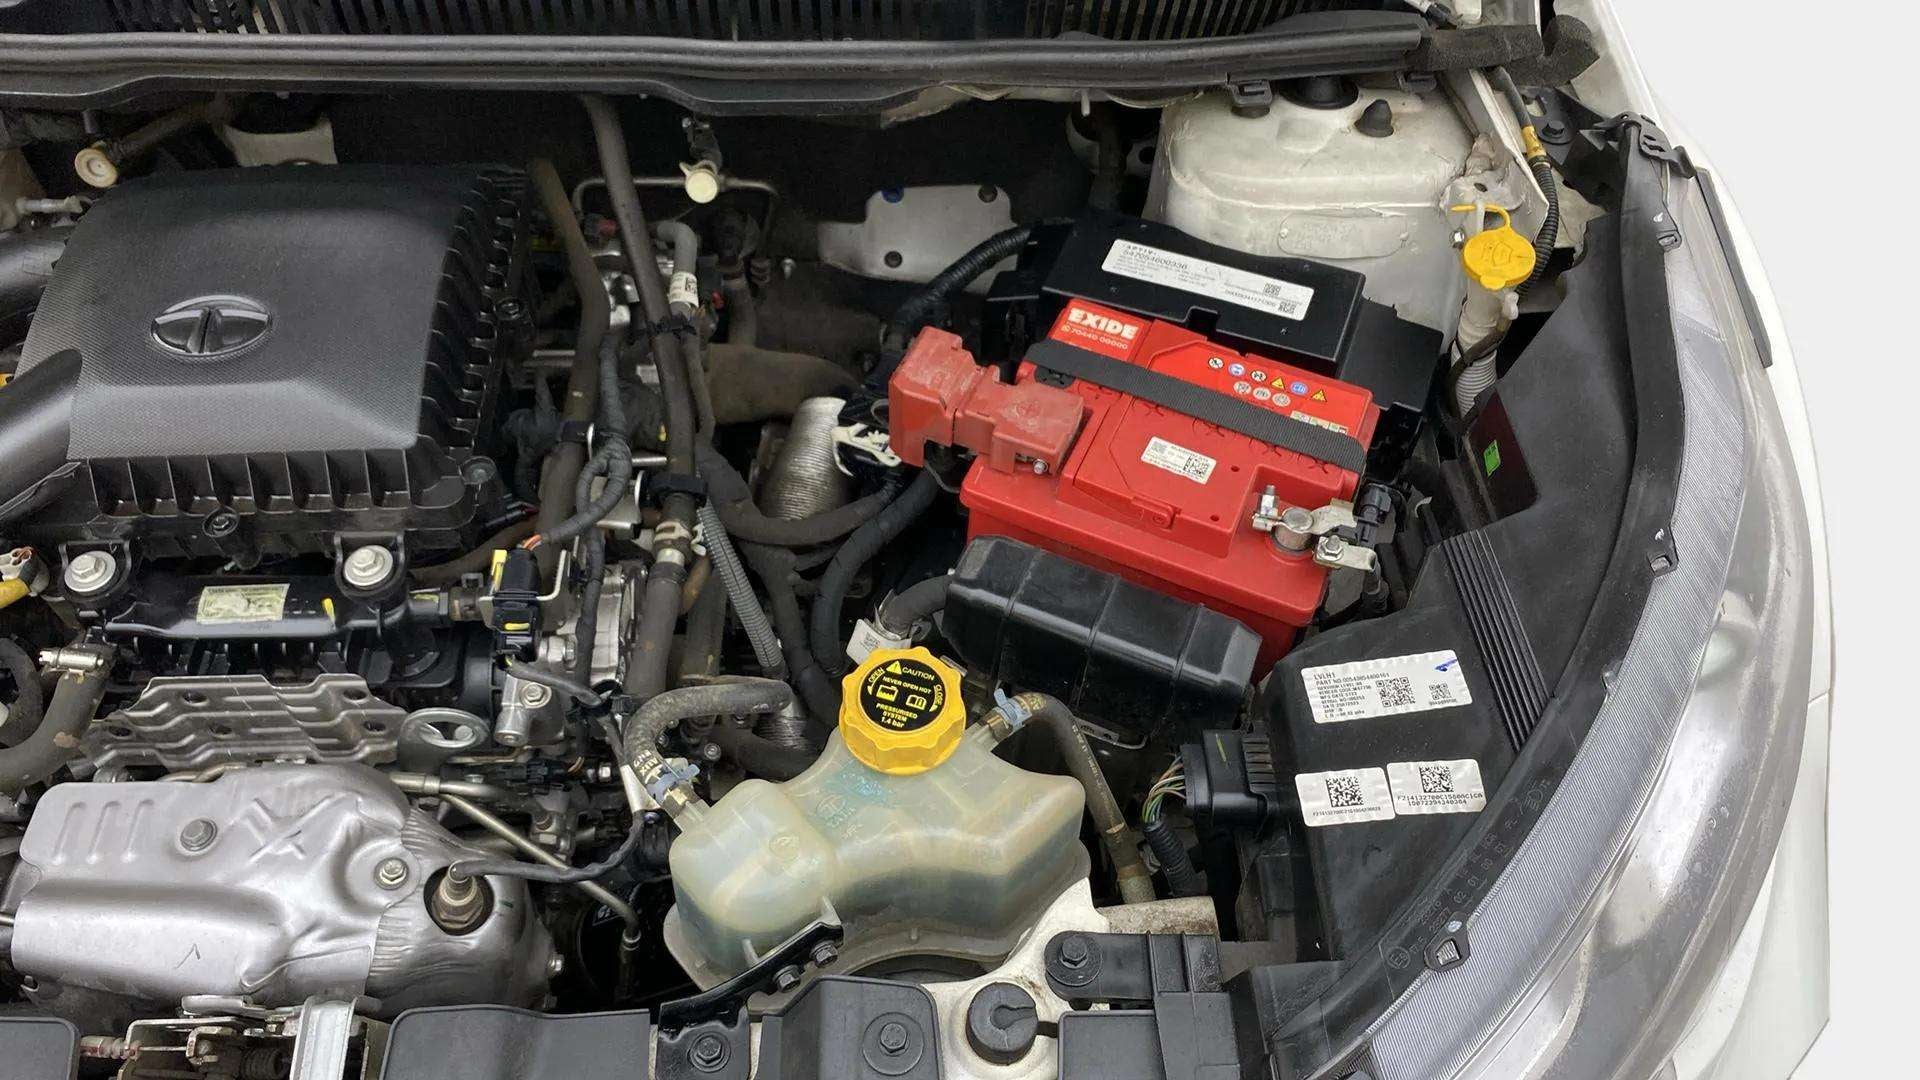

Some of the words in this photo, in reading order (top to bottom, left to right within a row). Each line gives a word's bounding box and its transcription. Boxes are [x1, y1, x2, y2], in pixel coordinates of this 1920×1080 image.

[1067, 307, 1139, 340] EXIDE
[1071, 328, 1099, 341] 70440
[868, 667, 886, 683] OPEN
[902, 666, 935, 681] CAUTION
[882, 676, 902, 686] NEVER
[902, 681, 919, 691] OPEN
[919, 686, 932, 694] HOT
[876, 703, 918, 720] PRESSURISED
[882, 710, 908, 722] SYSTEM
[881, 716, 892, 725] 1.4
[892, 719, 905, 728] bar
